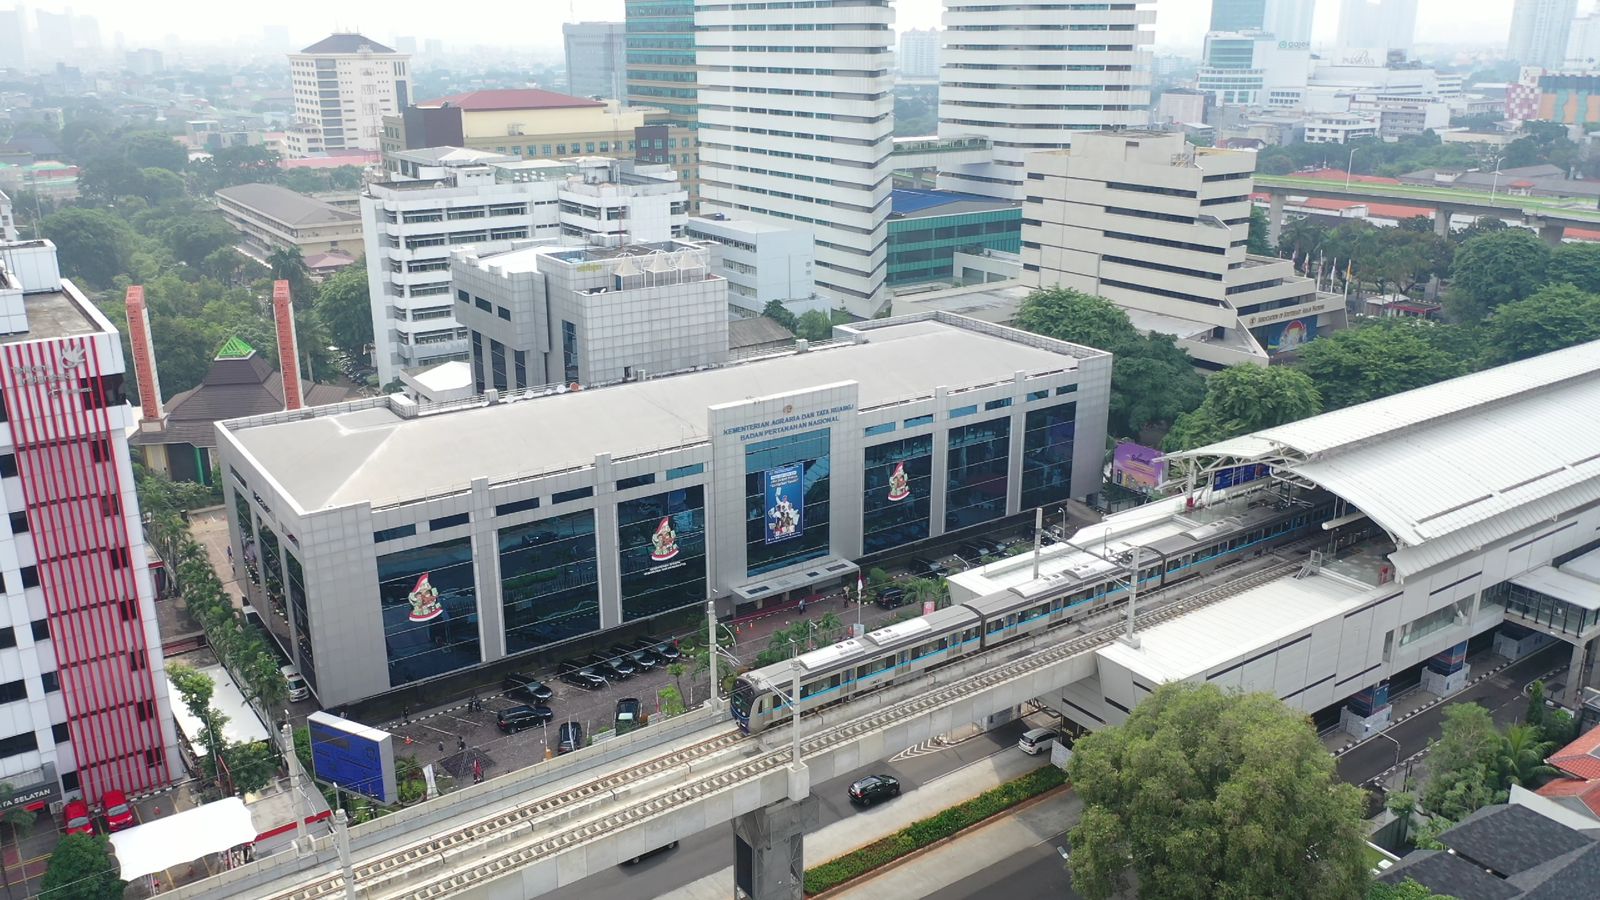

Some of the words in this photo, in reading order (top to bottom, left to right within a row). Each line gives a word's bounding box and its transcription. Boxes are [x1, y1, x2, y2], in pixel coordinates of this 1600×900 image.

[723, 421, 770, 436] KEMENTERIAN
[771, 415, 800, 426] AGRARIA
[801, 412, 815, 420] DAN
[816, 409, 829, 417] TATA
[740, 430, 763, 441] BADAN
[764, 421, 807, 436] PERTANAHAN
[808, 415, 839, 428] NASIONAL
[14, 788, 51, 804] SELATAN
